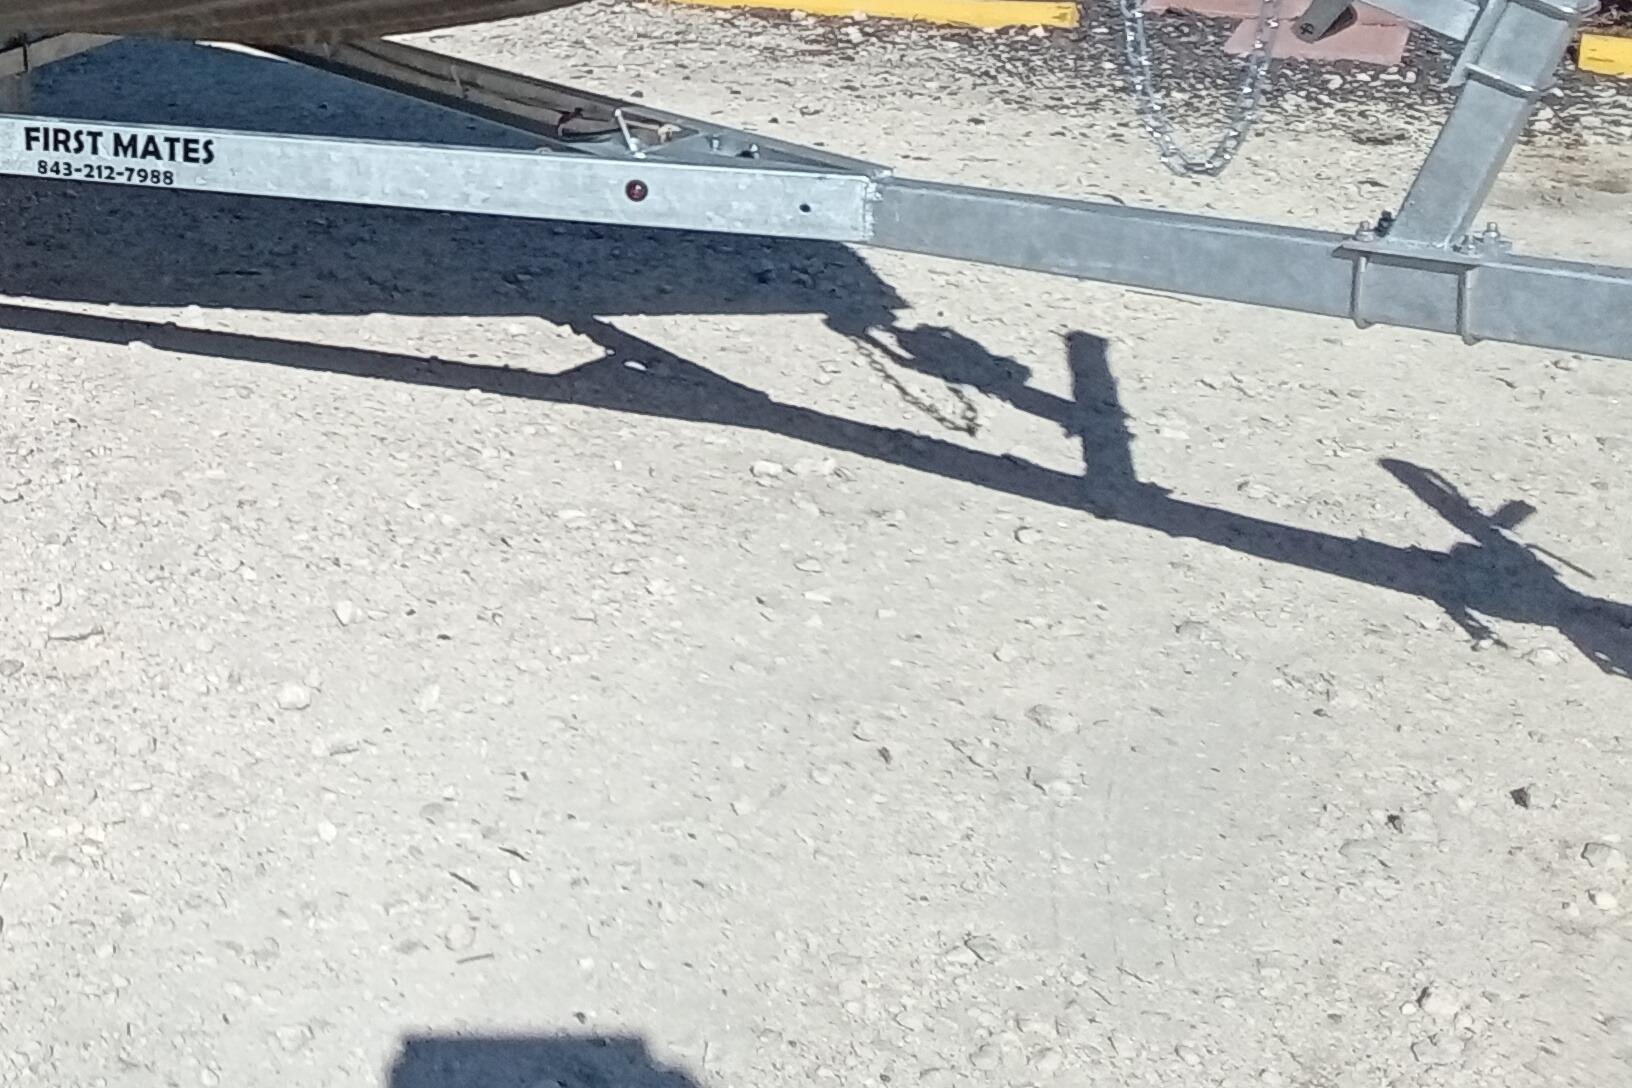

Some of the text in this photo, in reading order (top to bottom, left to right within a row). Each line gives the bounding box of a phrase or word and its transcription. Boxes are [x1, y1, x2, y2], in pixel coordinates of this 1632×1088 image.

[24, 126, 215, 164] FIRST MATES
[37, 160, 174, 185] 843-212-7988
